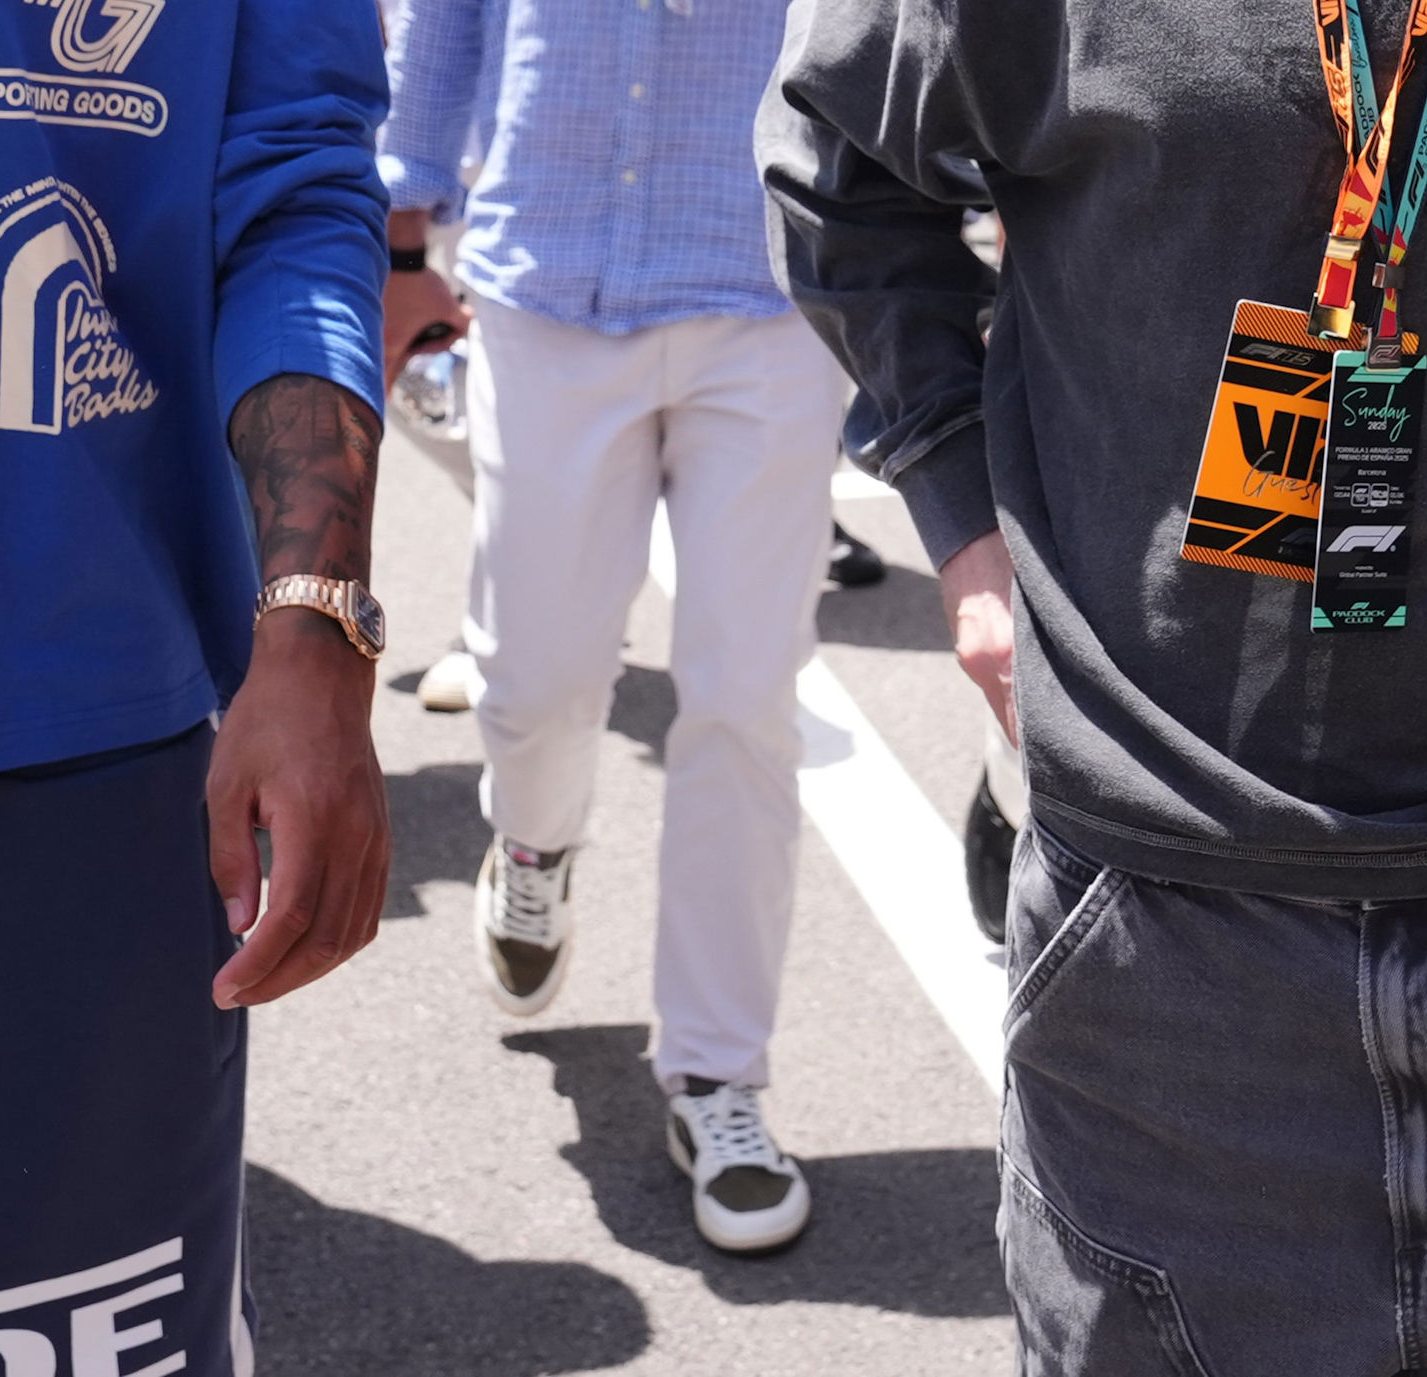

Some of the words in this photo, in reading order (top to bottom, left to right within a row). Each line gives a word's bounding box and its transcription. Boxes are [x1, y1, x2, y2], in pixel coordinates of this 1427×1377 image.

[73, 91, 156, 125] GOODS
[64, 336, 135, 386] City
[64, 369, 160, 428] Books
[1341, 384, 1411, 443] Sunday
[1232, 401, 1327, 484] VI
[1367, 420, 1387, 431] 2025
[1357, 468, 1387, 476] Barcelona
[1326, 525, 1406, 553] F1
[1332, 609, 1386, 618] PADDOCK
